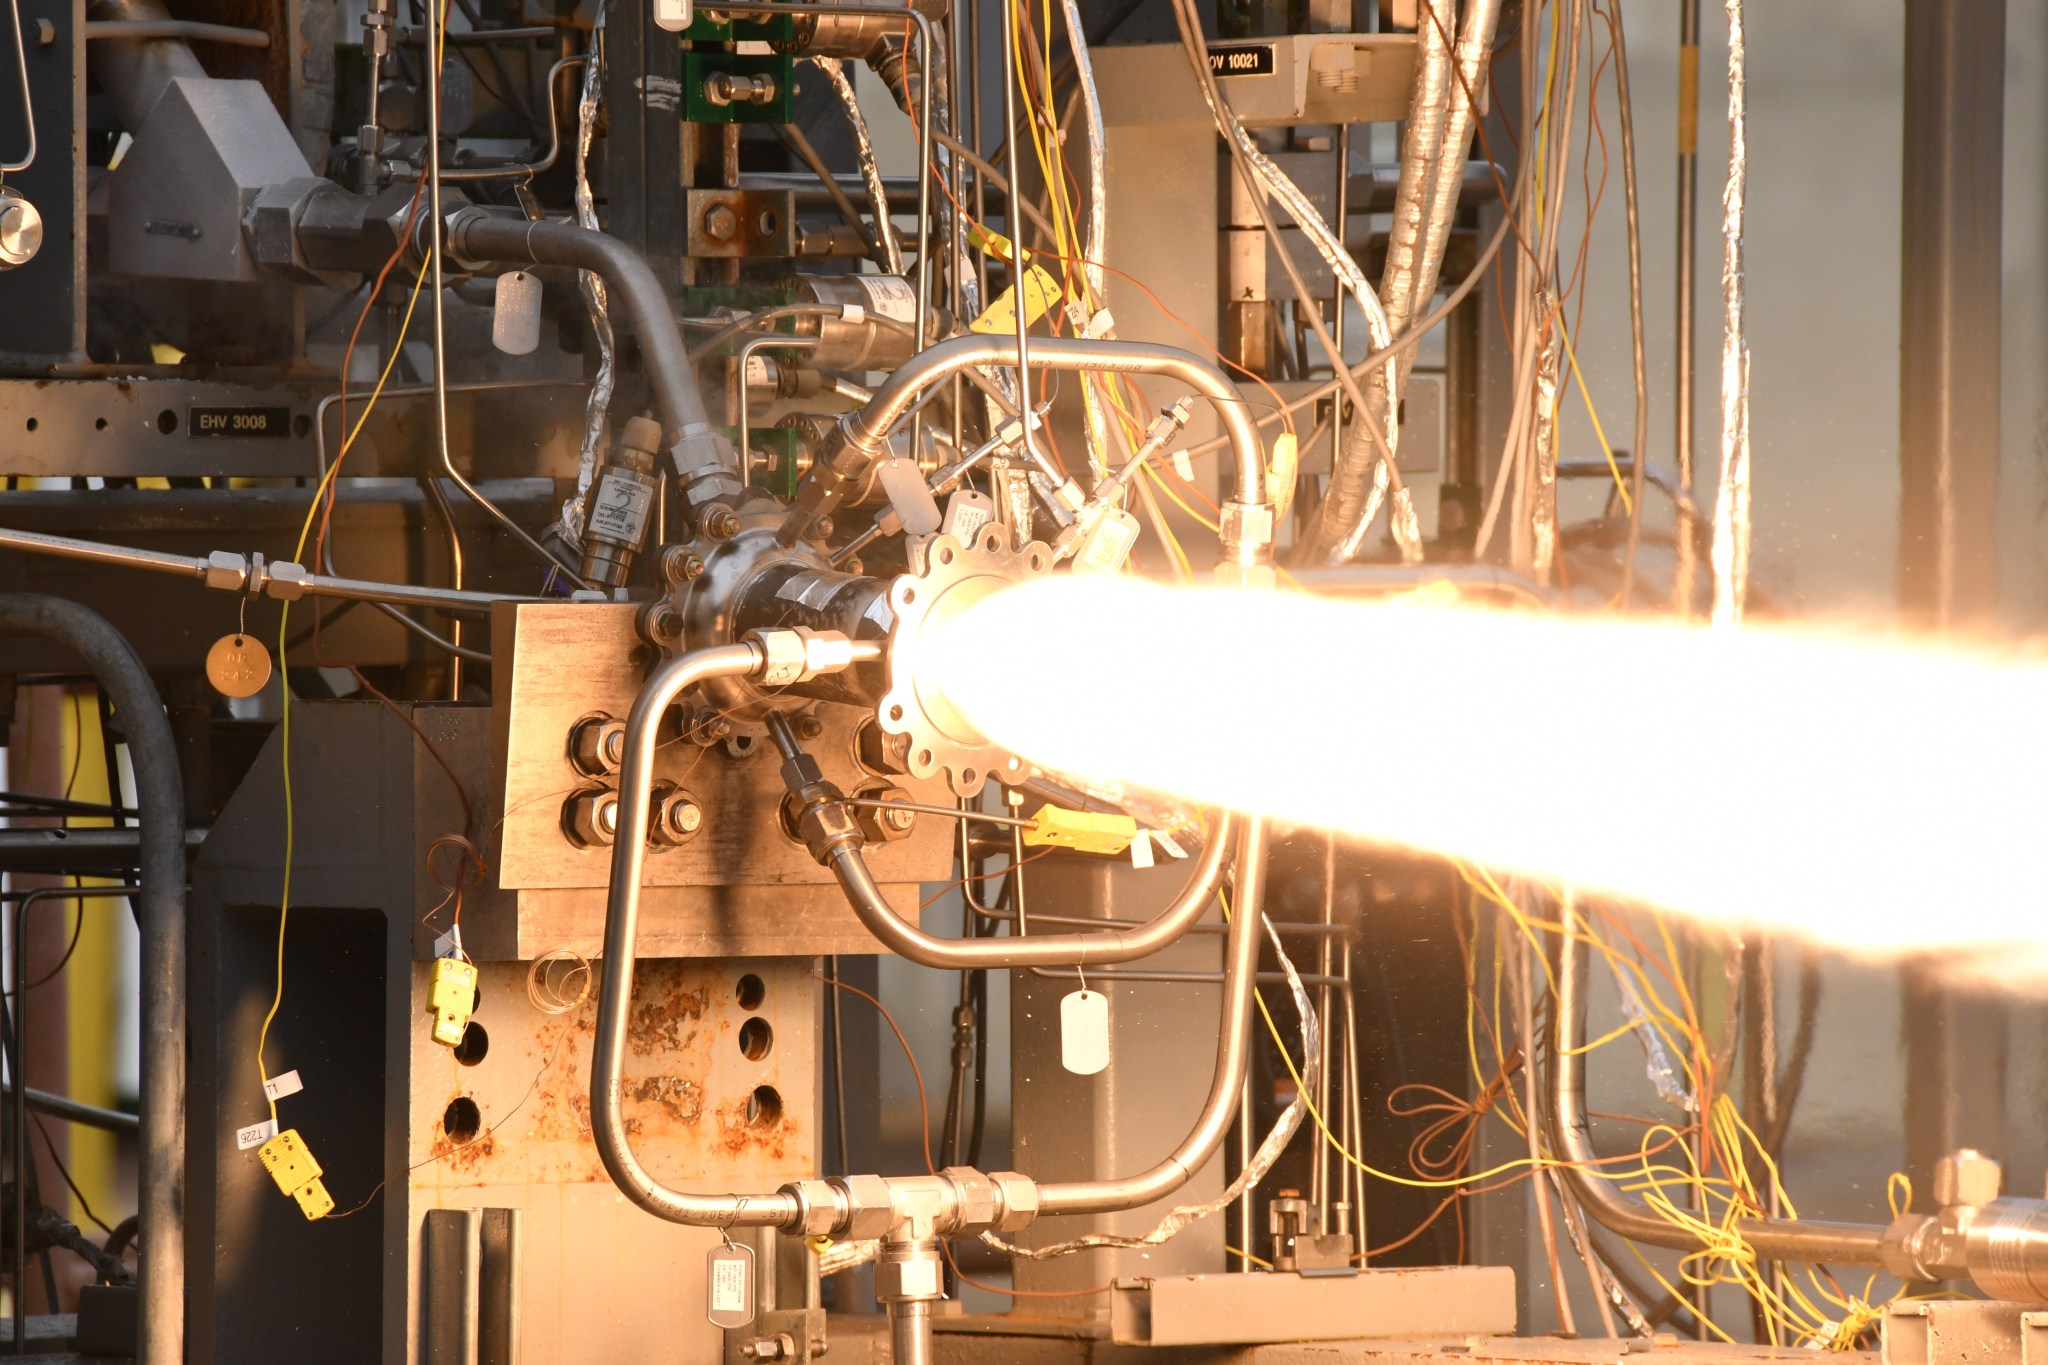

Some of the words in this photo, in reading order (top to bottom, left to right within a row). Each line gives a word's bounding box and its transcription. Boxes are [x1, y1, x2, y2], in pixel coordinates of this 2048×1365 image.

[1228, 53, 1258, 69] 10021
[200, 414, 228, 429] EHV
[232, 414, 267, 429] 3008
[266, 1083, 278, 1095] T1
[240, 1129, 263, 1144] T226
